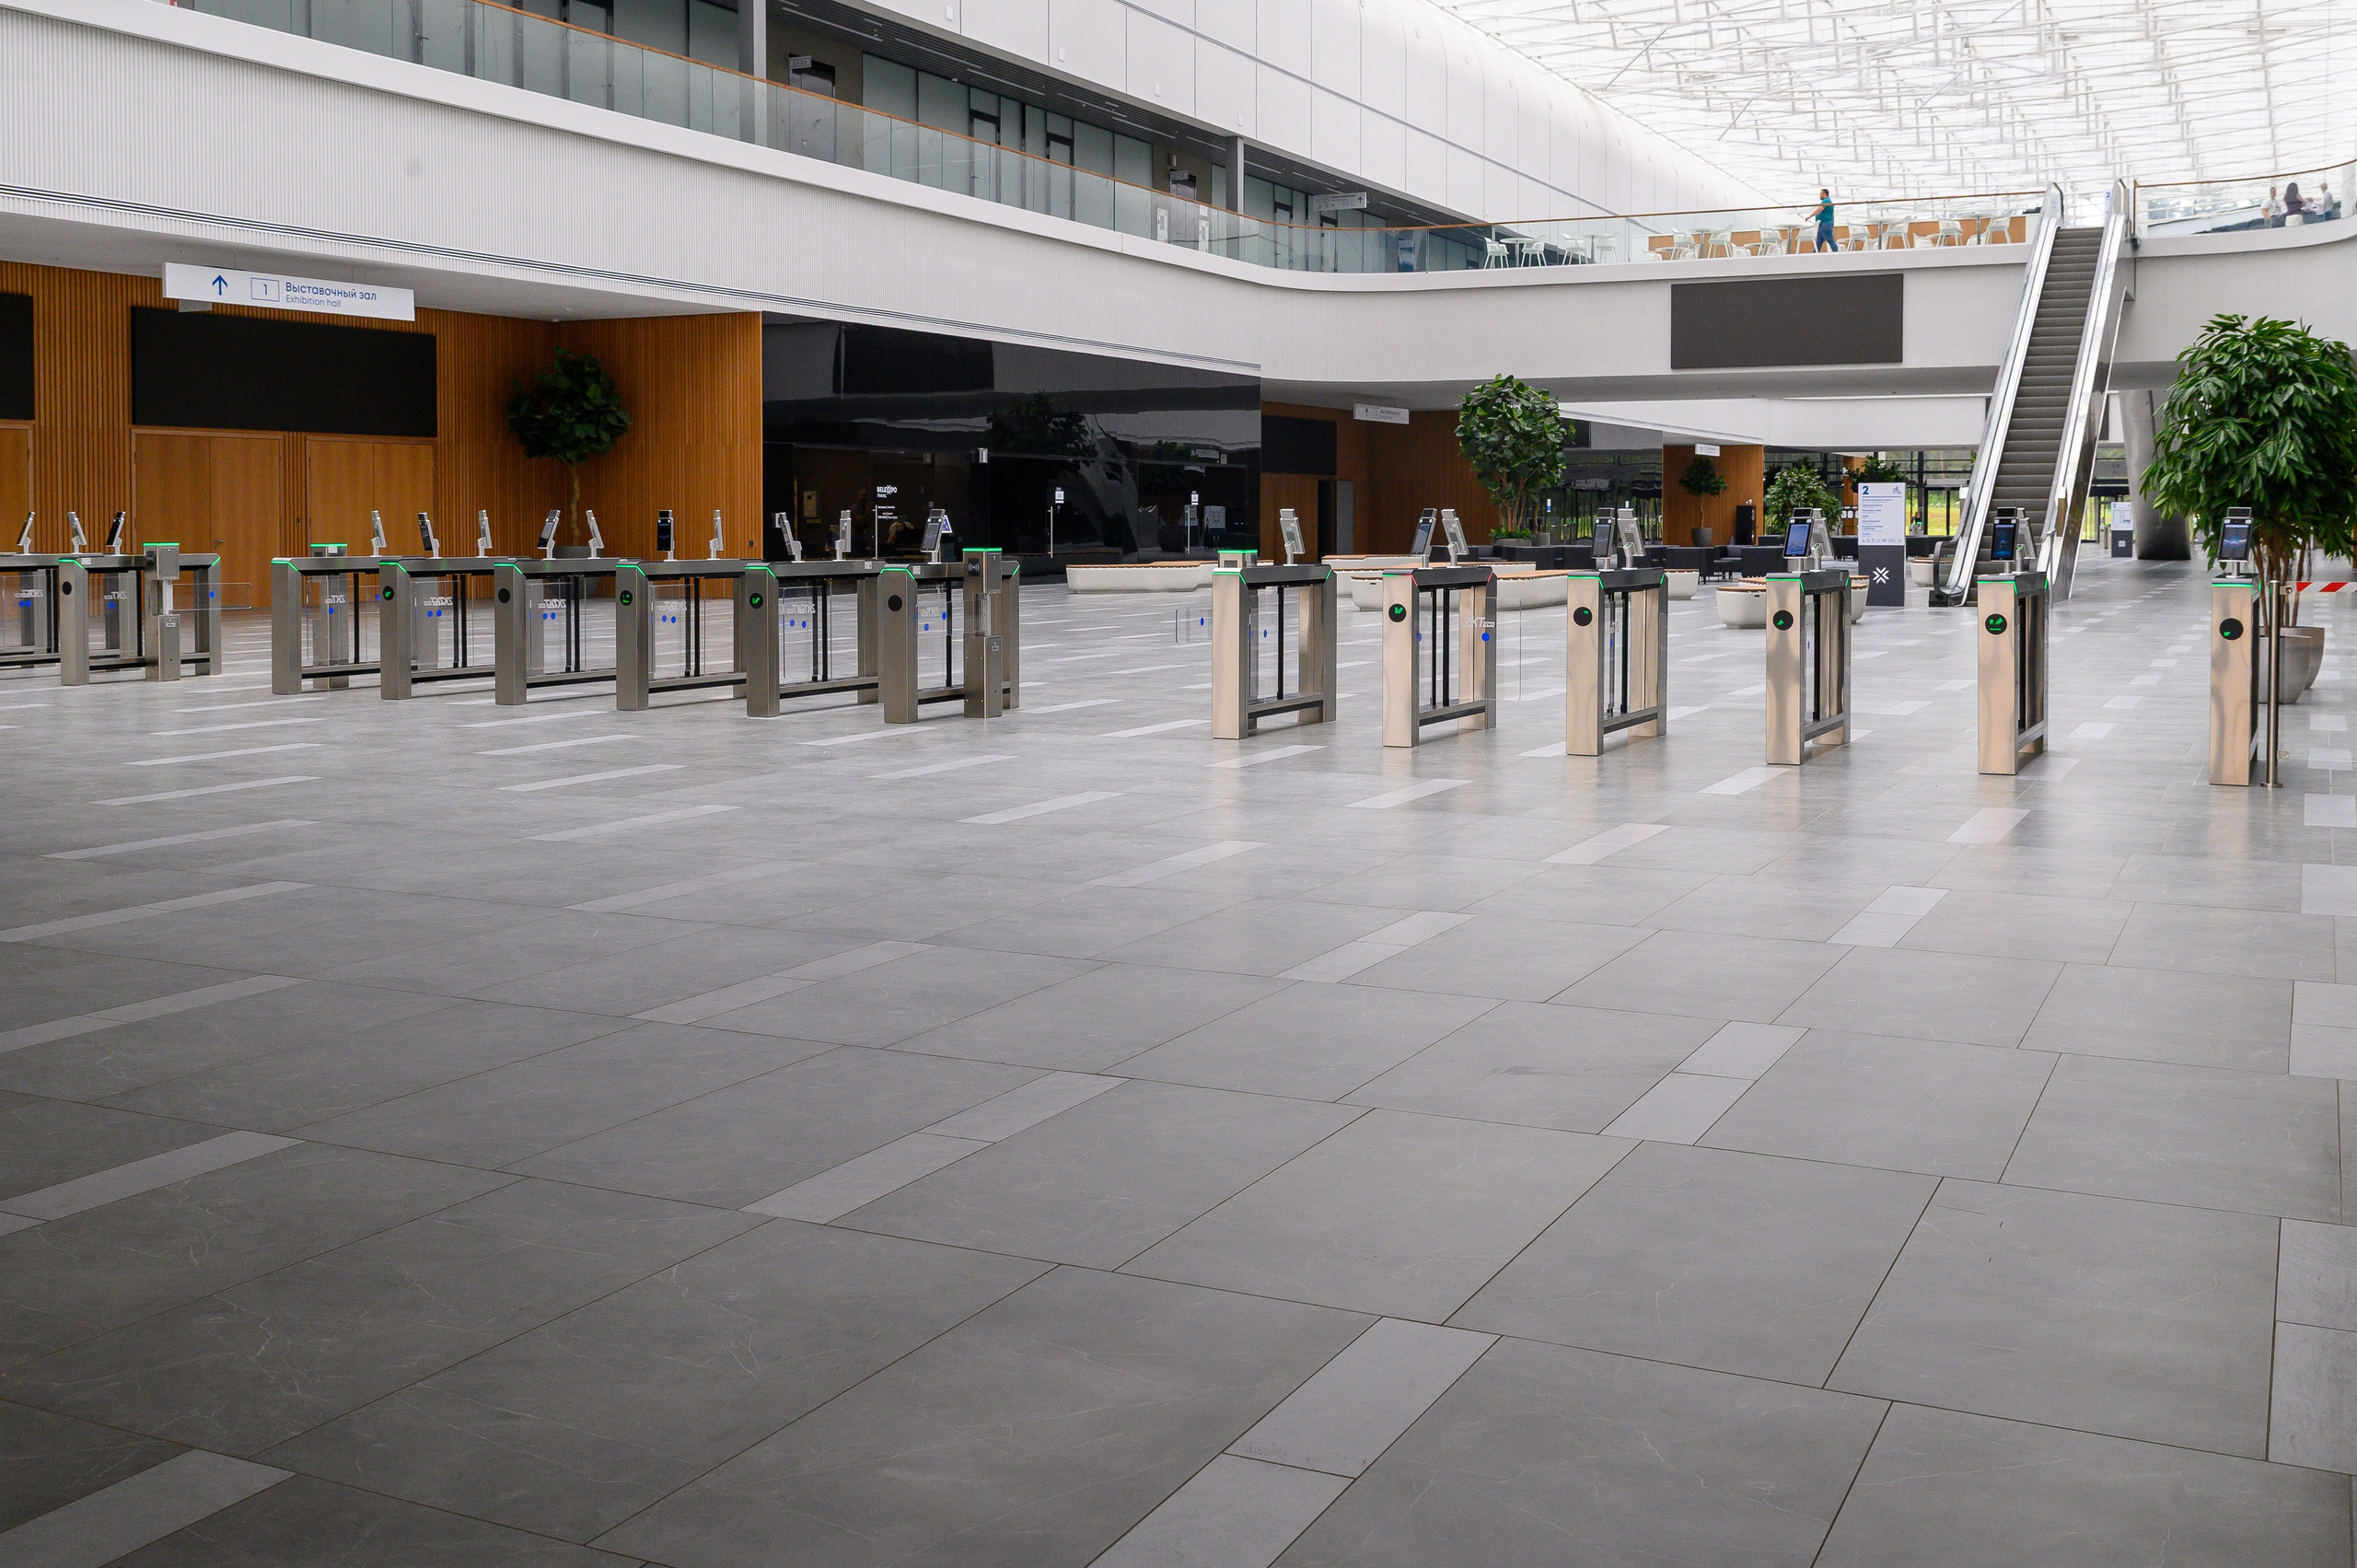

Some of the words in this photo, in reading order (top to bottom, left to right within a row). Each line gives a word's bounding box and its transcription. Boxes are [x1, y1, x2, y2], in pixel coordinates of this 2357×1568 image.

[263, 284, 269, 296] 1
[285, 282, 356, 299] Выставочный
[358, 290, 377, 301] зал
[285, 295, 324, 307] Exhibition
[326, 298, 342, 308] hall
[1862, 485, 1869, 495] 2
